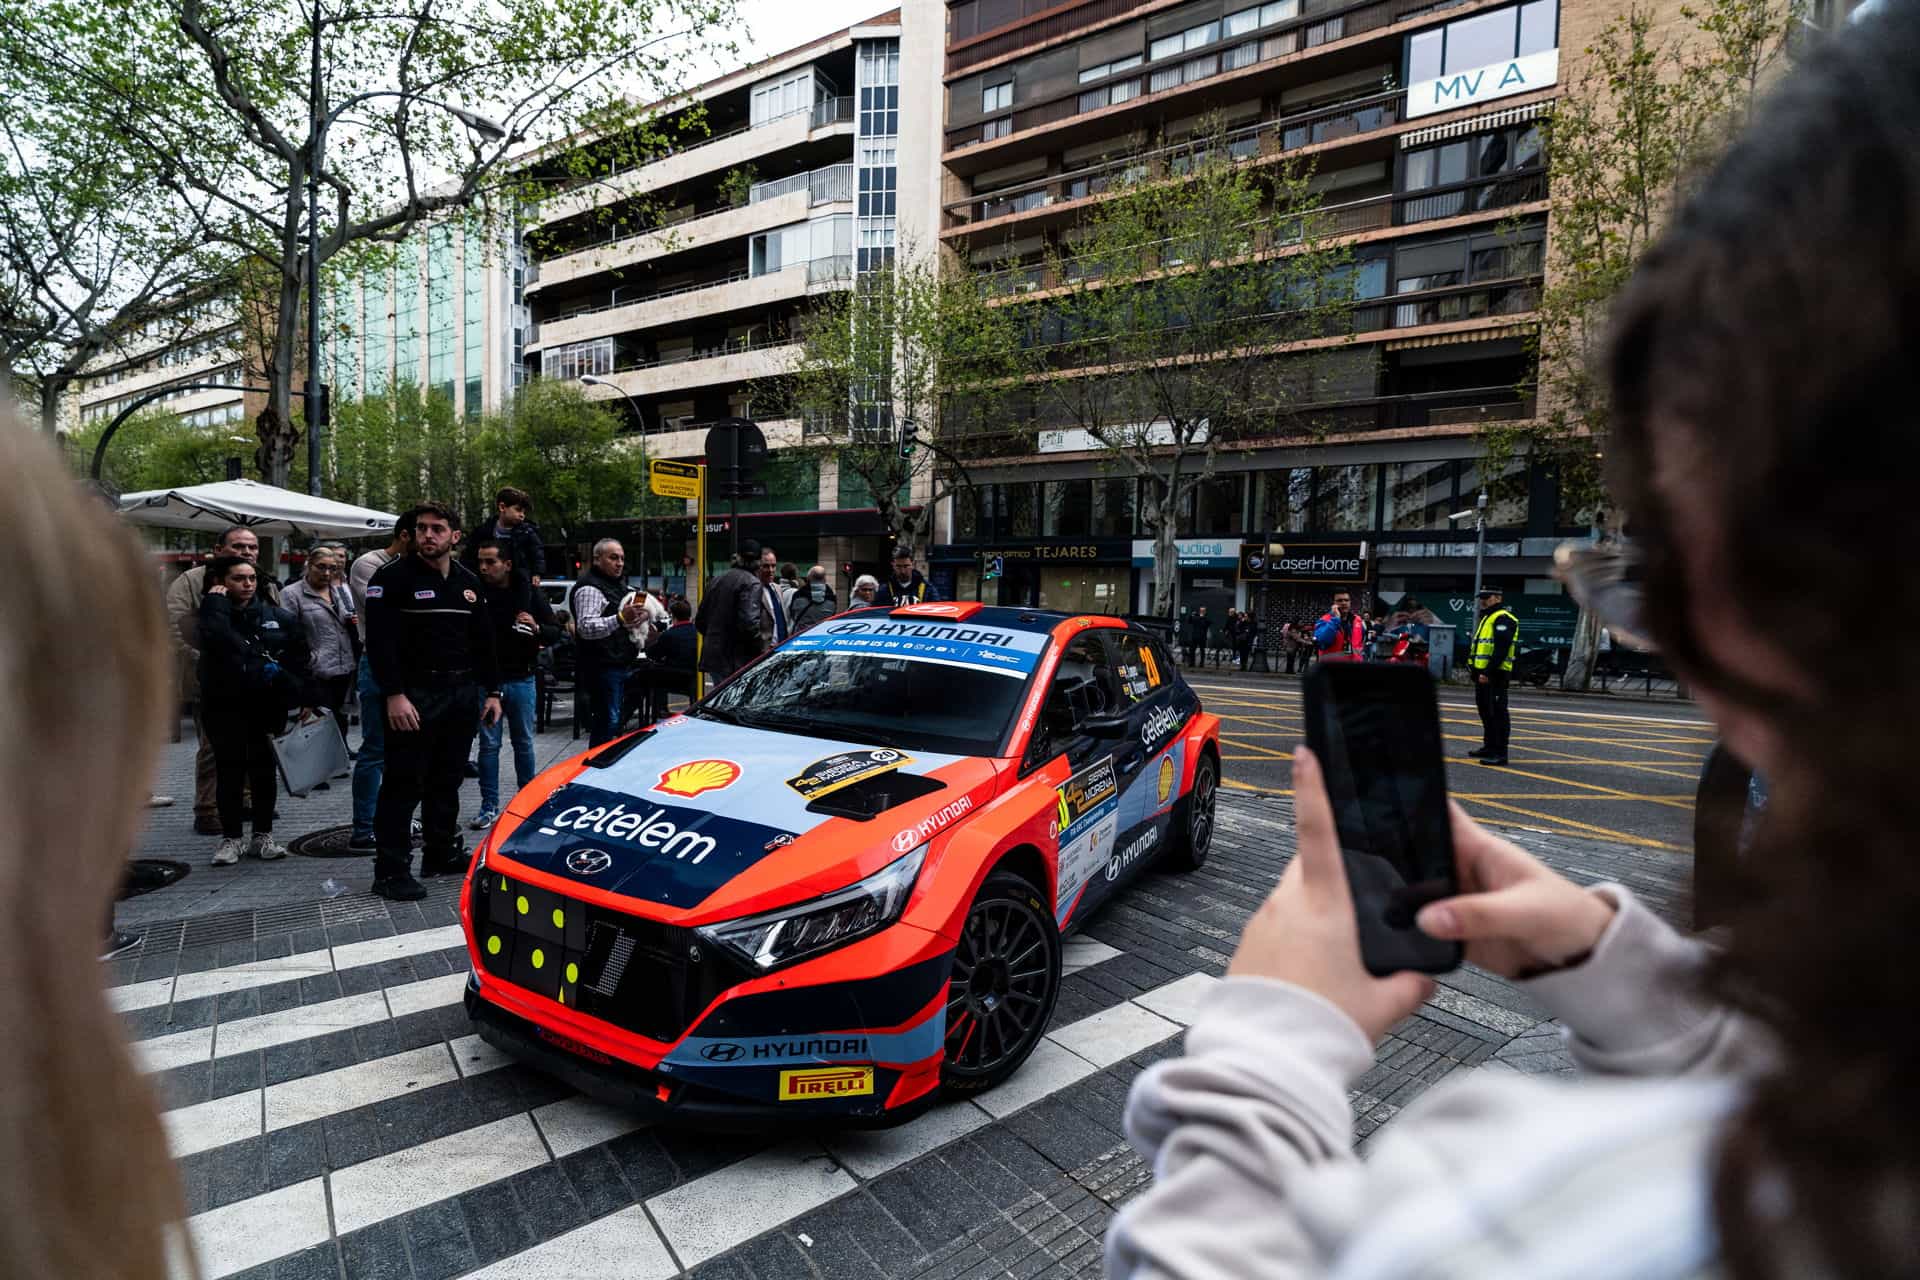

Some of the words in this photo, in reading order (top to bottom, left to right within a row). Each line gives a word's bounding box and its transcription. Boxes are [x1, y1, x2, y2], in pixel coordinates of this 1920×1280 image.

[1034, 546, 1097, 559] TEJARES
[874, 623, 1016, 647] HYUNDAI
[1138, 646, 1161, 688] 20
[1141, 704, 1179, 746] cetelem
[874, 751, 893, 761] 20
[1087, 764, 1111, 785] SIERRA
[1084, 777, 1114, 801] MORENA
[917, 795, 973, 838] HYUNDAI
[553, 803, 717, 864] cetelem
[1122, 825, 1158, 869] HYUNDAI
[753, 1038, 868, 1059] HYUNDAI
[787, 1070, 865, 1095] PIRELLI
